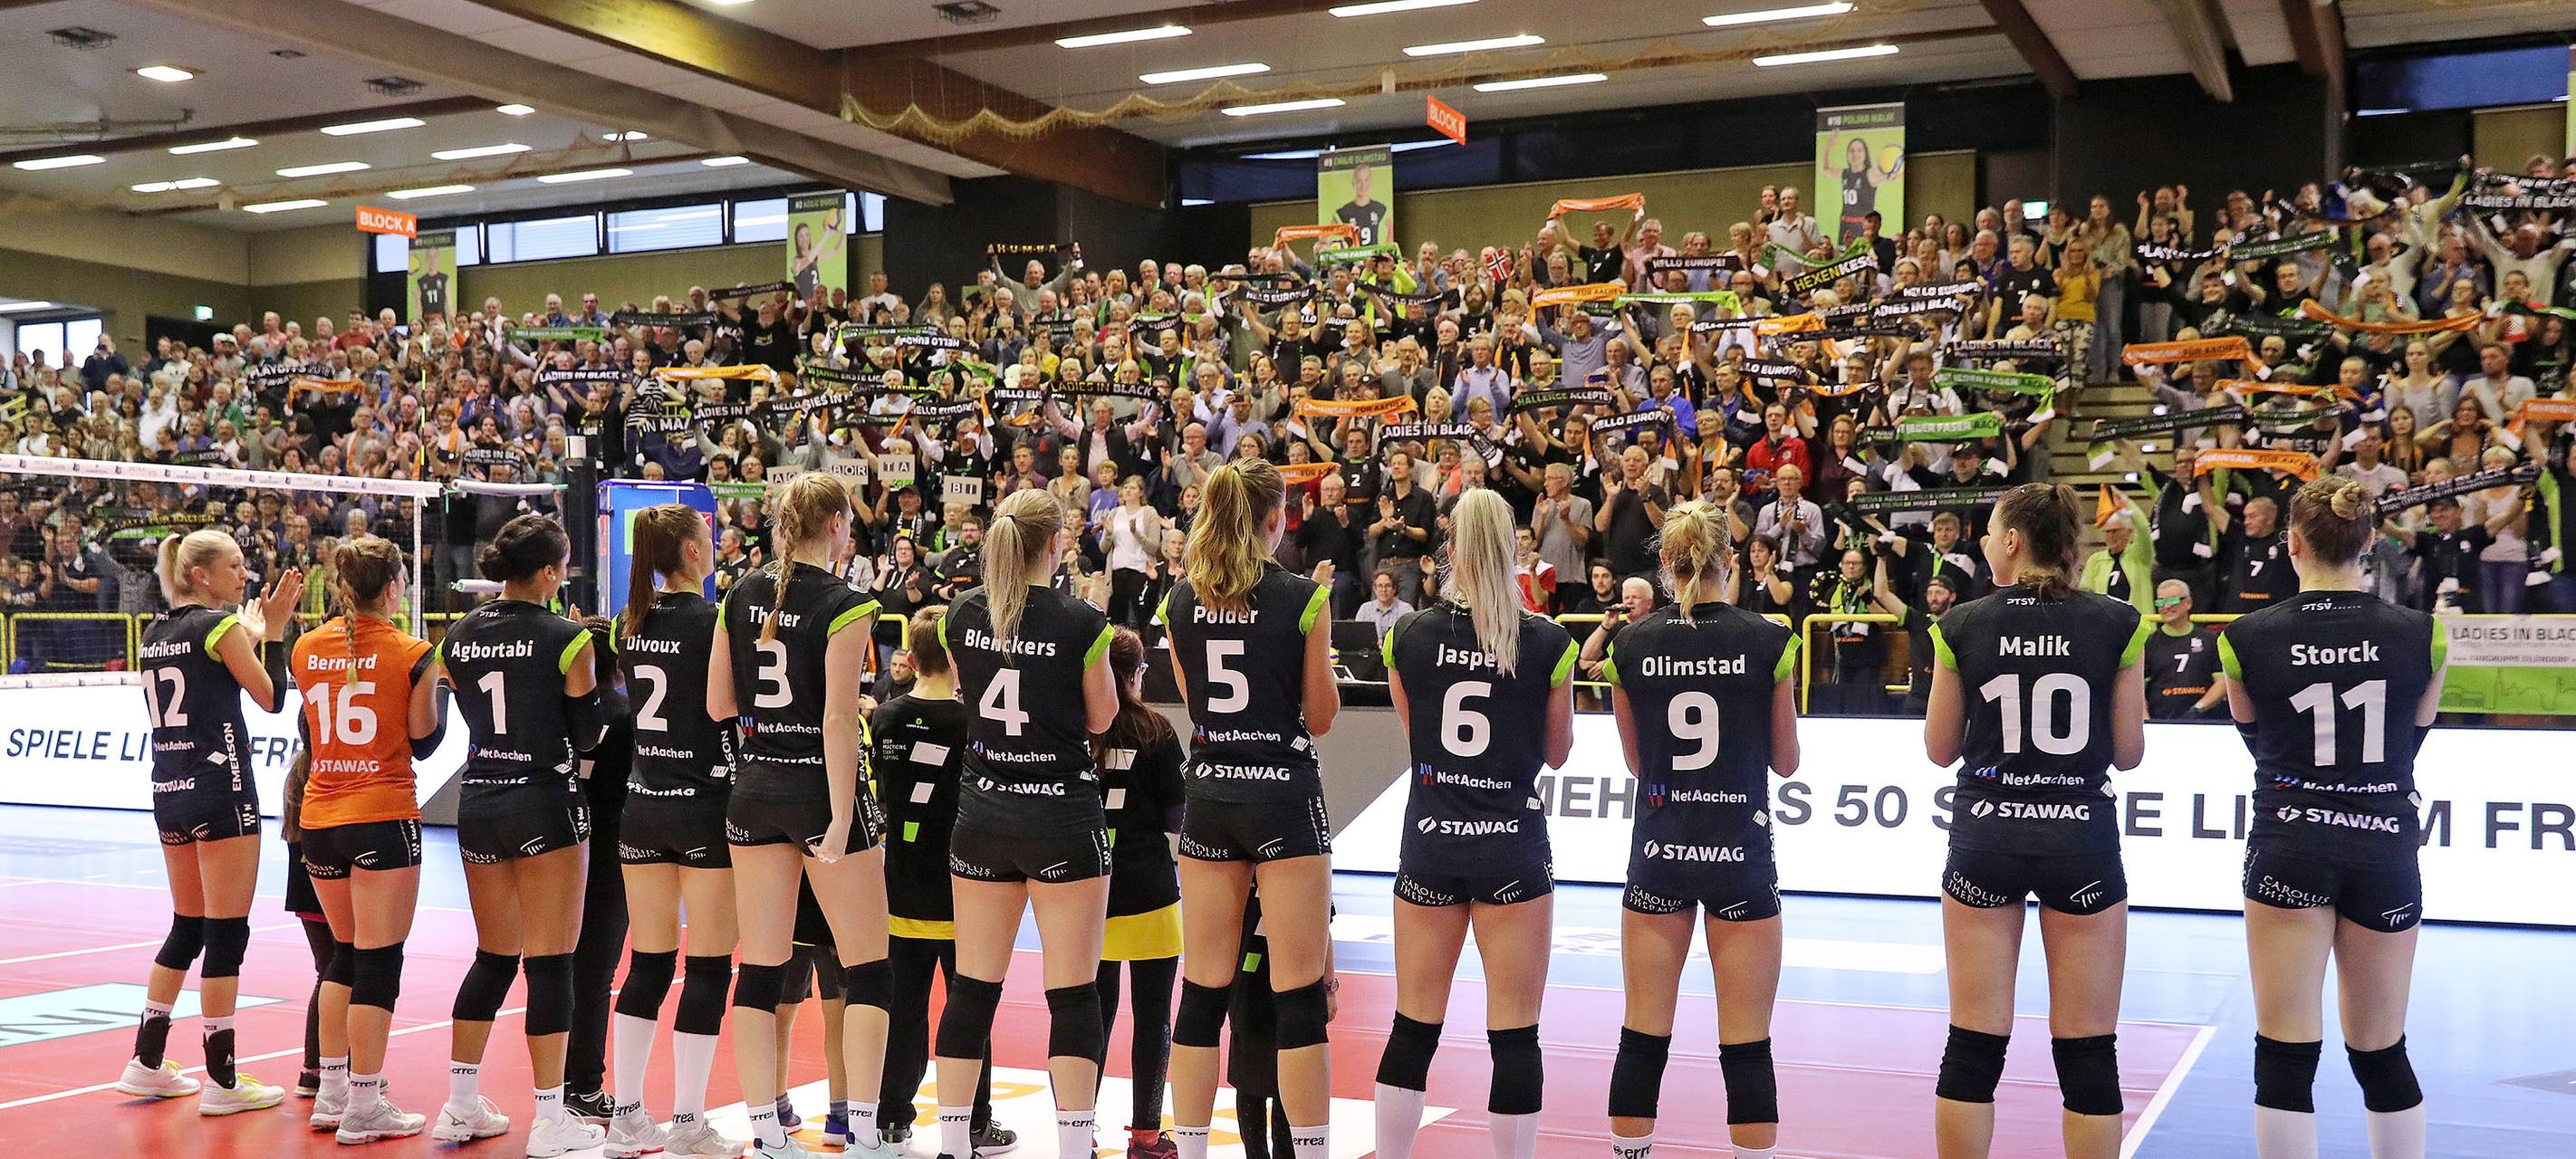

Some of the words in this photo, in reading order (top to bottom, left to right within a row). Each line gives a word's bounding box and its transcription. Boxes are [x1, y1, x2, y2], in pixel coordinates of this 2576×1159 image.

[1429, 104, 1457, 133] BLOCK
[1456, 121, 1465, 139] B
[1842, 188, 1858, 206] 10
[360, 211, 404, 232] BLOCK
[405, 219, 415, 234] A
[1360, 227, 1371, 244] 9
[1652, 259, 1682, 268] HELLO
[2018, 290, 2027, 303] 7
[1873, 301, 1908, 319] ADIES
[539, 371, 573, 383] LADIES
[574, 371, 587, 380] IN
[587, 370, 620, 381] BLACK
[994, 389, 1024, 399] HELLO
[1051, 381, 1094, 393] LADIES
[1096, 383, 1110, 393] IN
[1112, 383, 1152, 397] BLACK
[1516, 392, 1568, 407] HALLENGE
[694, 406, 728, 420] LADIES
[1591, 417, 1625, 432] HELLO
[1626, 410, 1670, 425] EUROPE!
[1382, 425, 1421, 439] ADIES
[1423, 424, 1437, 436] IN
[465, 449, 492, 459] ADIES
[1350, 474, 1360, 487] 2
[2250, 560, 2264, 577] 7
[2007, 597, 2035, 606] PTSV
[2301, 599, 2332, 612] PTSV
[748, 605, 801, 628] Thter
[2451, 627, 2508, 640] LADIES
[2513, 627, 2530, 640] IN
[140, 641, 191, 659] ndriksen
[451, 639, 534, 663] Agbortabi
[626, 634, 680, 655] Divoux
[1999, 635, 2071, 656] Malik
[2290, 639, 2379, 666] Storck
[1437, 644, 1497, 672] Jaspe
[1641, 654, 1746, 677] Olimstad
[2174, 654, 2190, 674] 7
[753, 638, 793, 709] 3
[1206, 639, 1250, 714] 5
[141, 666, 188, 729] 12
[477, 671, 507, 735] 1
[634, 665, 668, 733] 2
[979, 667, 1030, 736] 4
[306, 681, 378, 746] 16
[1440, 681, 1493, 757] 6
[1979, 673, 2091, 755] 10
[757, 723, 822, 735] NetAachen
[1668, 691, 1720, 771] 9
[2289, 680, 2388, 767] 11
[1208, 729, 1281, 742] NetAachen
[5, 729, 111, 761] SPIELE
[638, 743, 694, 760] NetAachen
[223, 723, 242, 792] EMERSON
[986, 749, 1057, 762] NetAachen
[320, 760, 380, 773] STAWAG
[1215, 764, 1292, 781] STAWAG
[1437, 771, 1512, 790] NetAachen
[2002, 771, 2085, 786] NetAachen
[1671, 789, 1747, 804] NetAachen
[1833, 784, 1908, 829] 50
[1998, 802, 2091, 821] STAWAG
[1439, 819, 1519, 837] STAWAG
[2305, 808, 2400, 834] STAWAG
[1662, 844, 1745, 862] STAWAG
[1403, 874, 1455, 902] CAROLUS
[1633, 884, 1684, 907] CAROLUS
[1953, 870, 2008, 905] CAROLUS
[451, 1067, 477, 1076] errea
[351, 1079, 378, 1088] errea
[534, 1093, 556, 1102] rrea
[1293, 1135, 1325, 1147] errea
